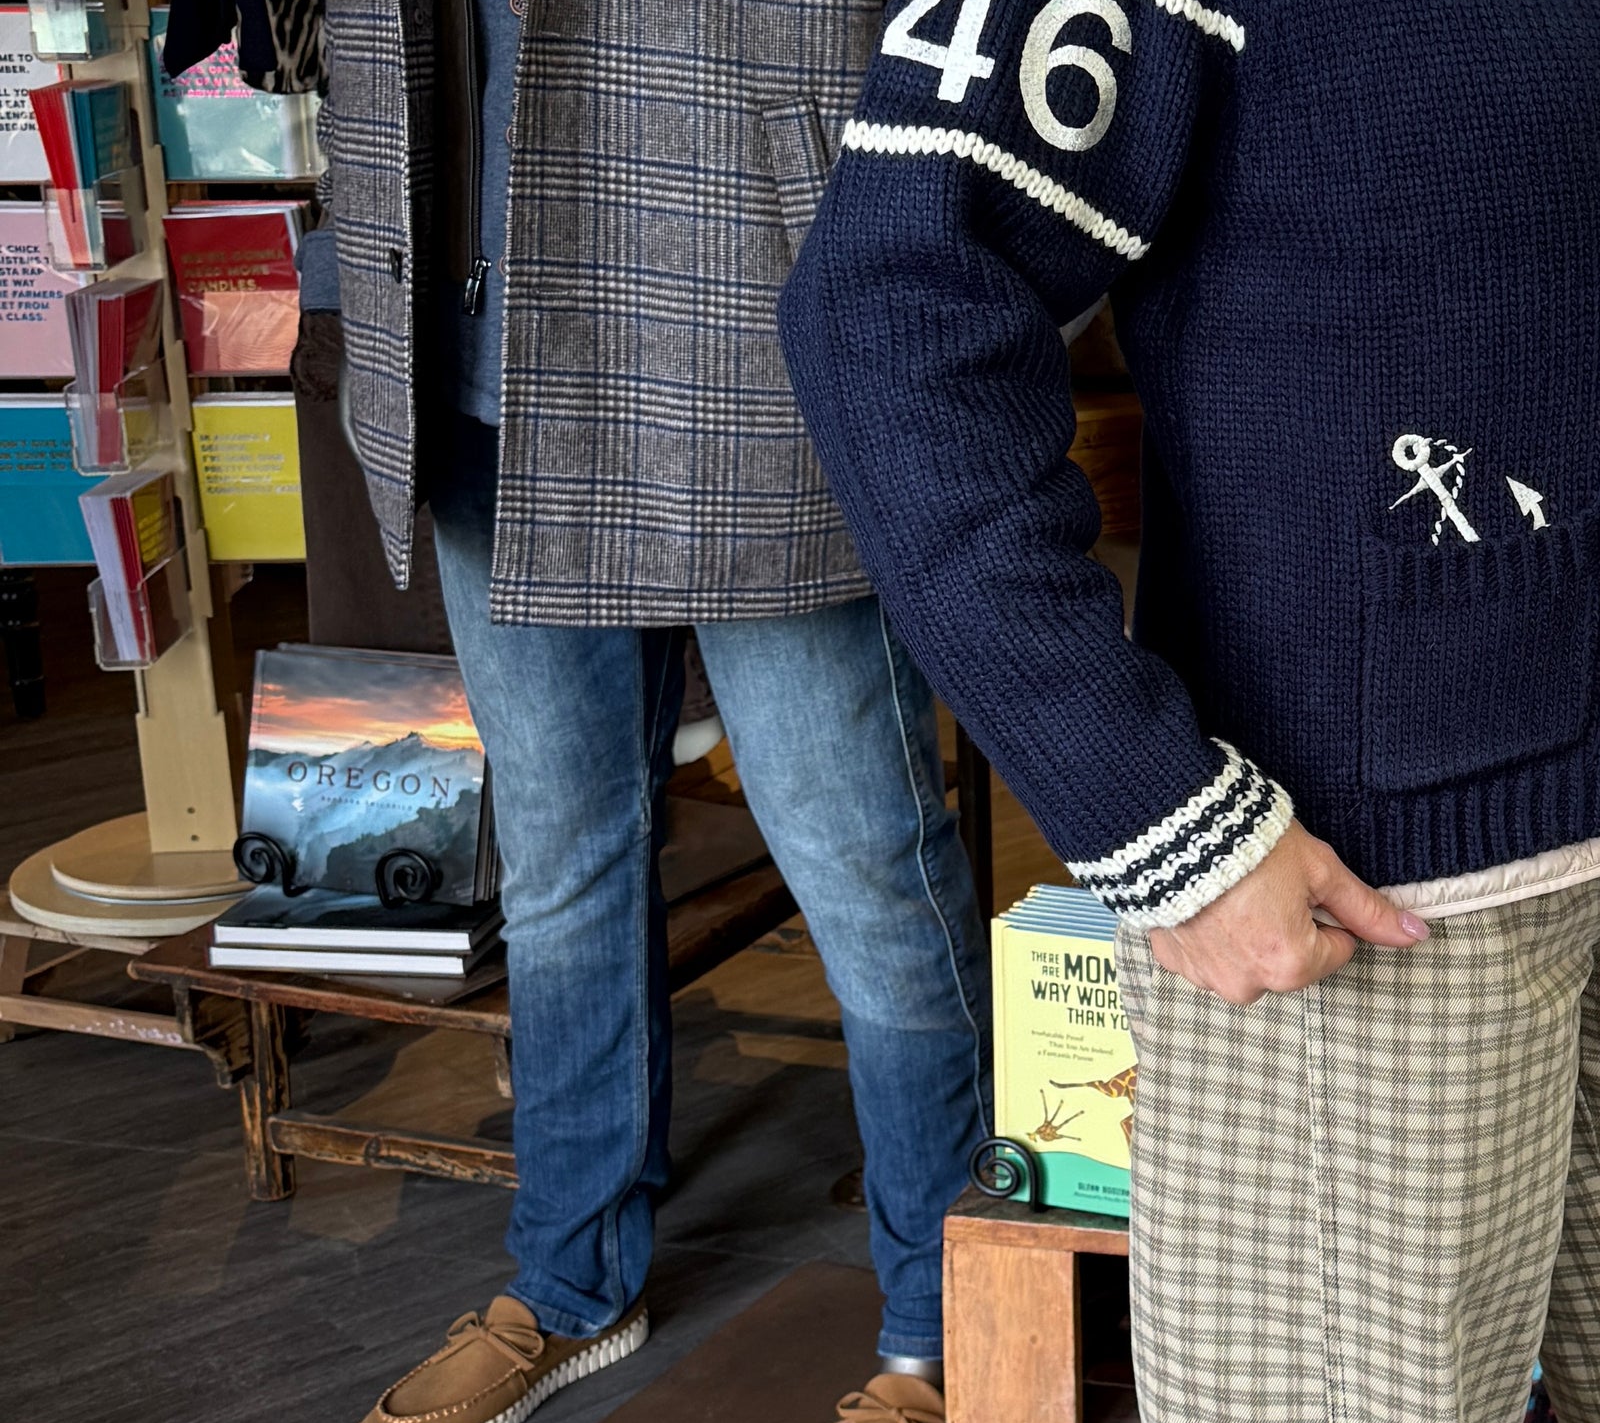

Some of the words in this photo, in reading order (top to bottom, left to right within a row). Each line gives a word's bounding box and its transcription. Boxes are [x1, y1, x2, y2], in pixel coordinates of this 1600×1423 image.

[17, 54, 33, 62] TO
[7, 245, 40, 253] CHICK
[187, 279, 262, 293] CANDLES.
[6, 313, 47, 321] CLASS.
[287, 761, 452, 798] OREGON
[1031, 950, 1060, 965] THERE
[1042, 965, 1060, 978] ARE
[1031, 979, 1071, 1003] WAY
[1066, 1007, 1105, 1028] THAN
